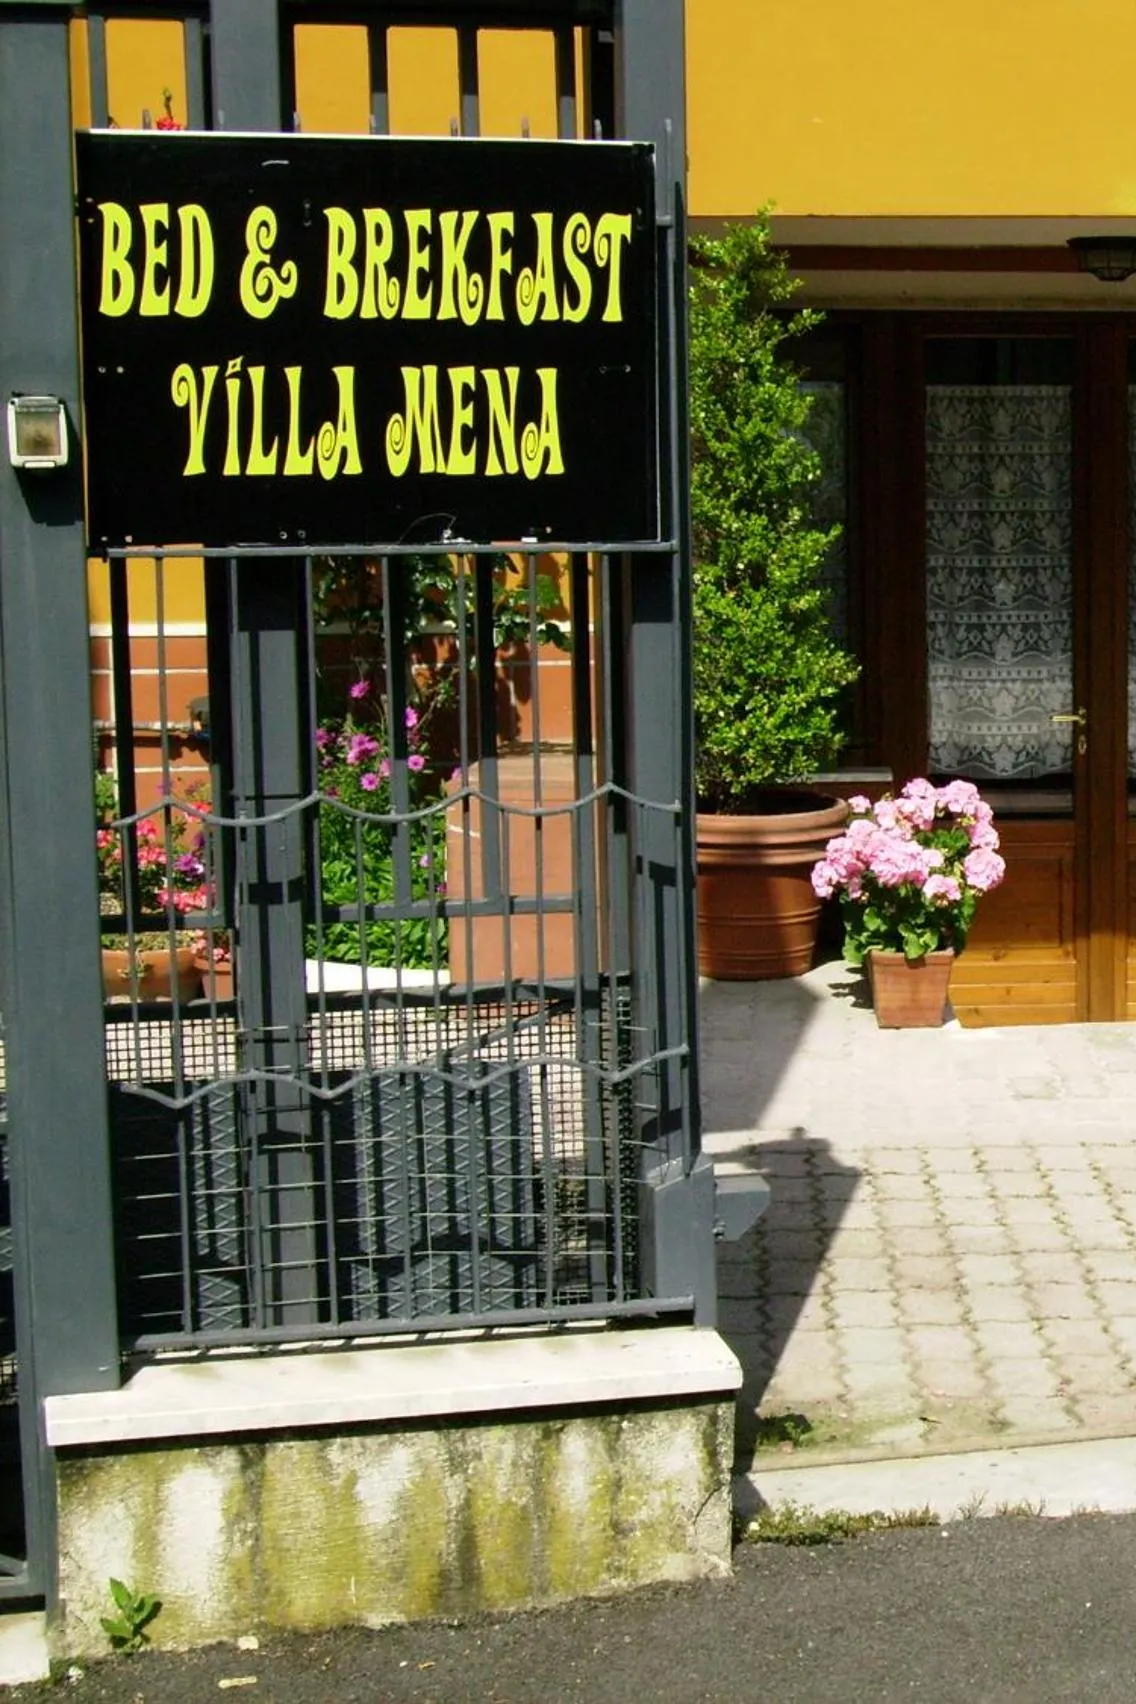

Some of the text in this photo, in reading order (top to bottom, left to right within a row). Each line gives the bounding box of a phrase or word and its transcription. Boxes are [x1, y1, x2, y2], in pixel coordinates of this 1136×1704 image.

[97, 201, 633, 326] BED & BREKFAST
[385, 364, 565, 480] MENA
